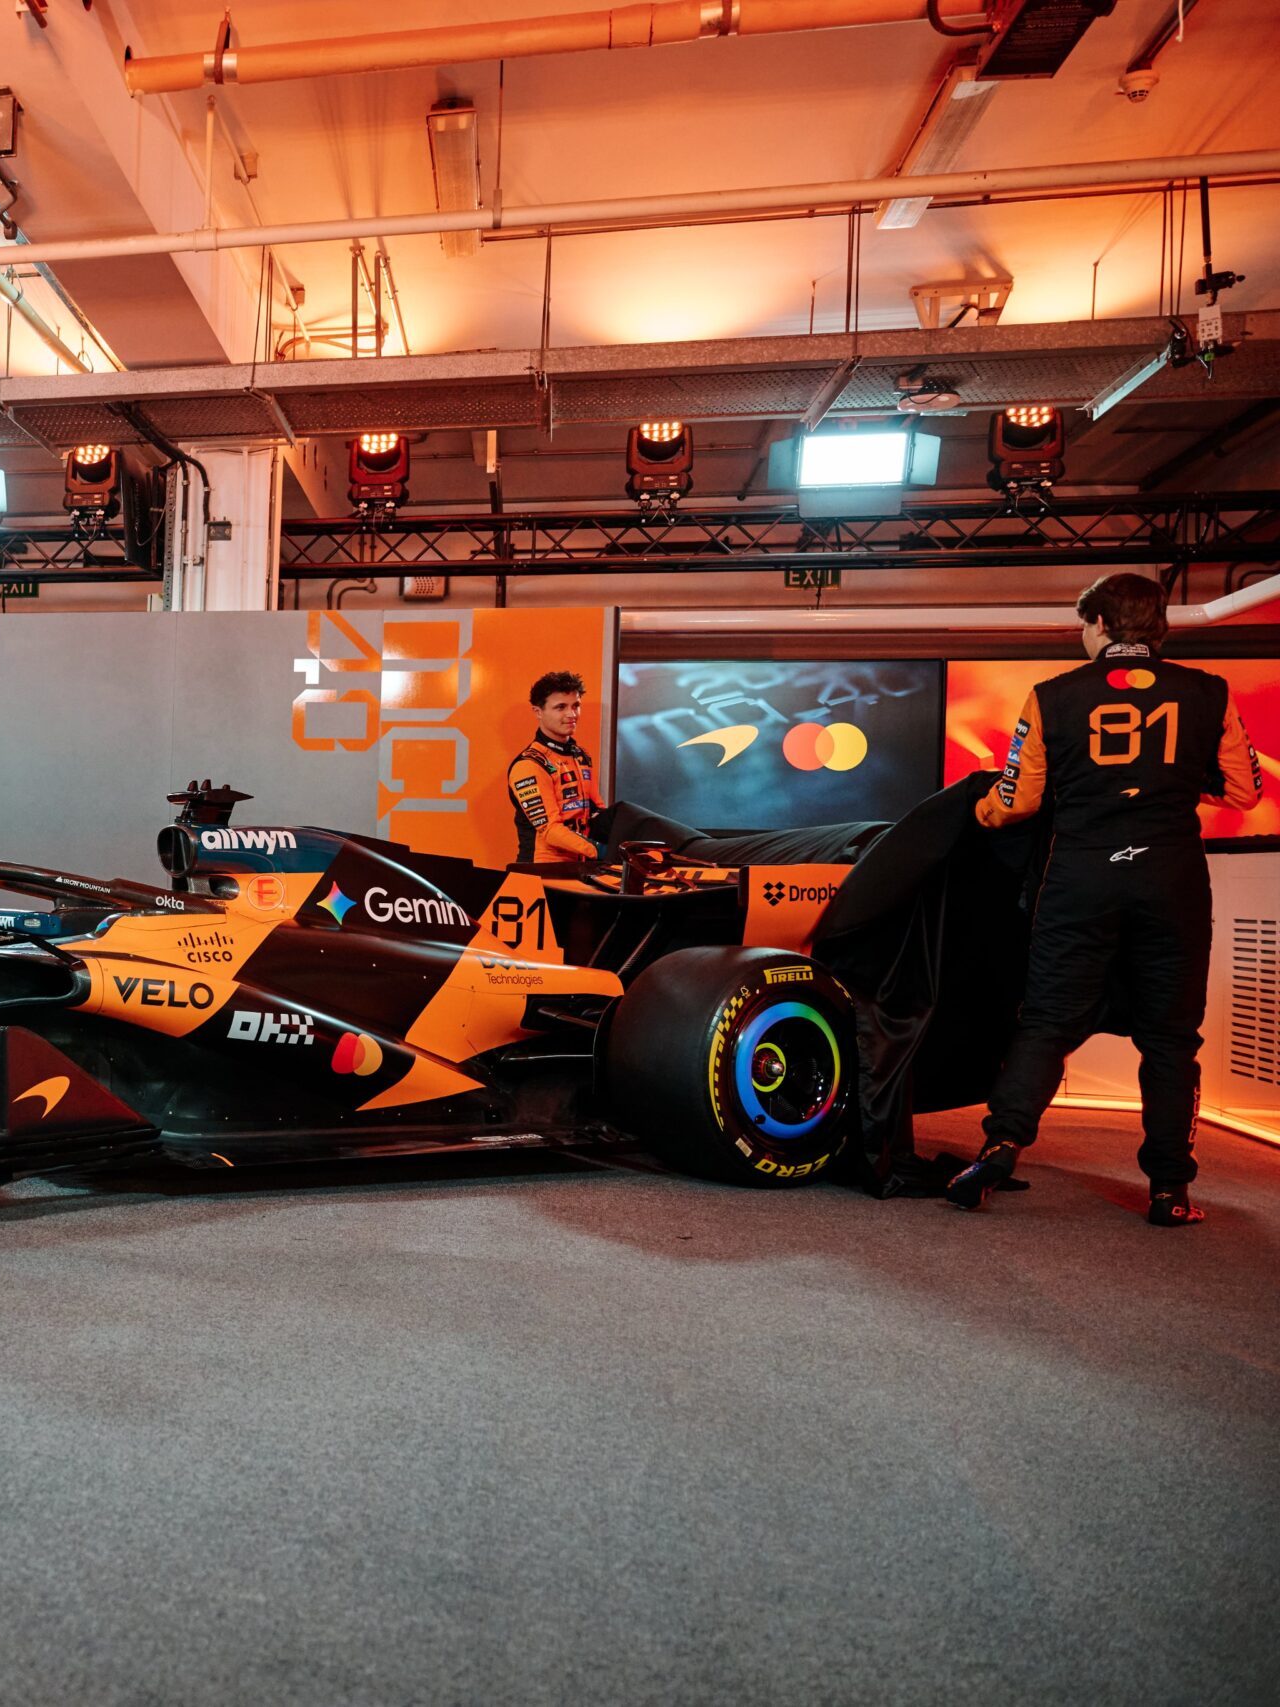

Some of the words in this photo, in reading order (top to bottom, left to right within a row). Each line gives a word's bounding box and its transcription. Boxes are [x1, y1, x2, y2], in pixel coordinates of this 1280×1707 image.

[1089, 702, 1179, 766] 81
[201, 828, 297, 855] allwyn
[63, 878, 79, 887] IRON
[79, 881, 111, 894] MOUNTAIN
[789, 883, 839, 905] Dropb
[155, 895, 185, 910] okta
[491, 896, 546, 951] 81
[485, 972, 543, 987] Technologies
[763, 965, 814, 984] PIRELLI
[113, 975, 214, 1010] VELO
[226, 1010, 315, 1045] OKX
[754, 1153, 831, 1178] ZERO
